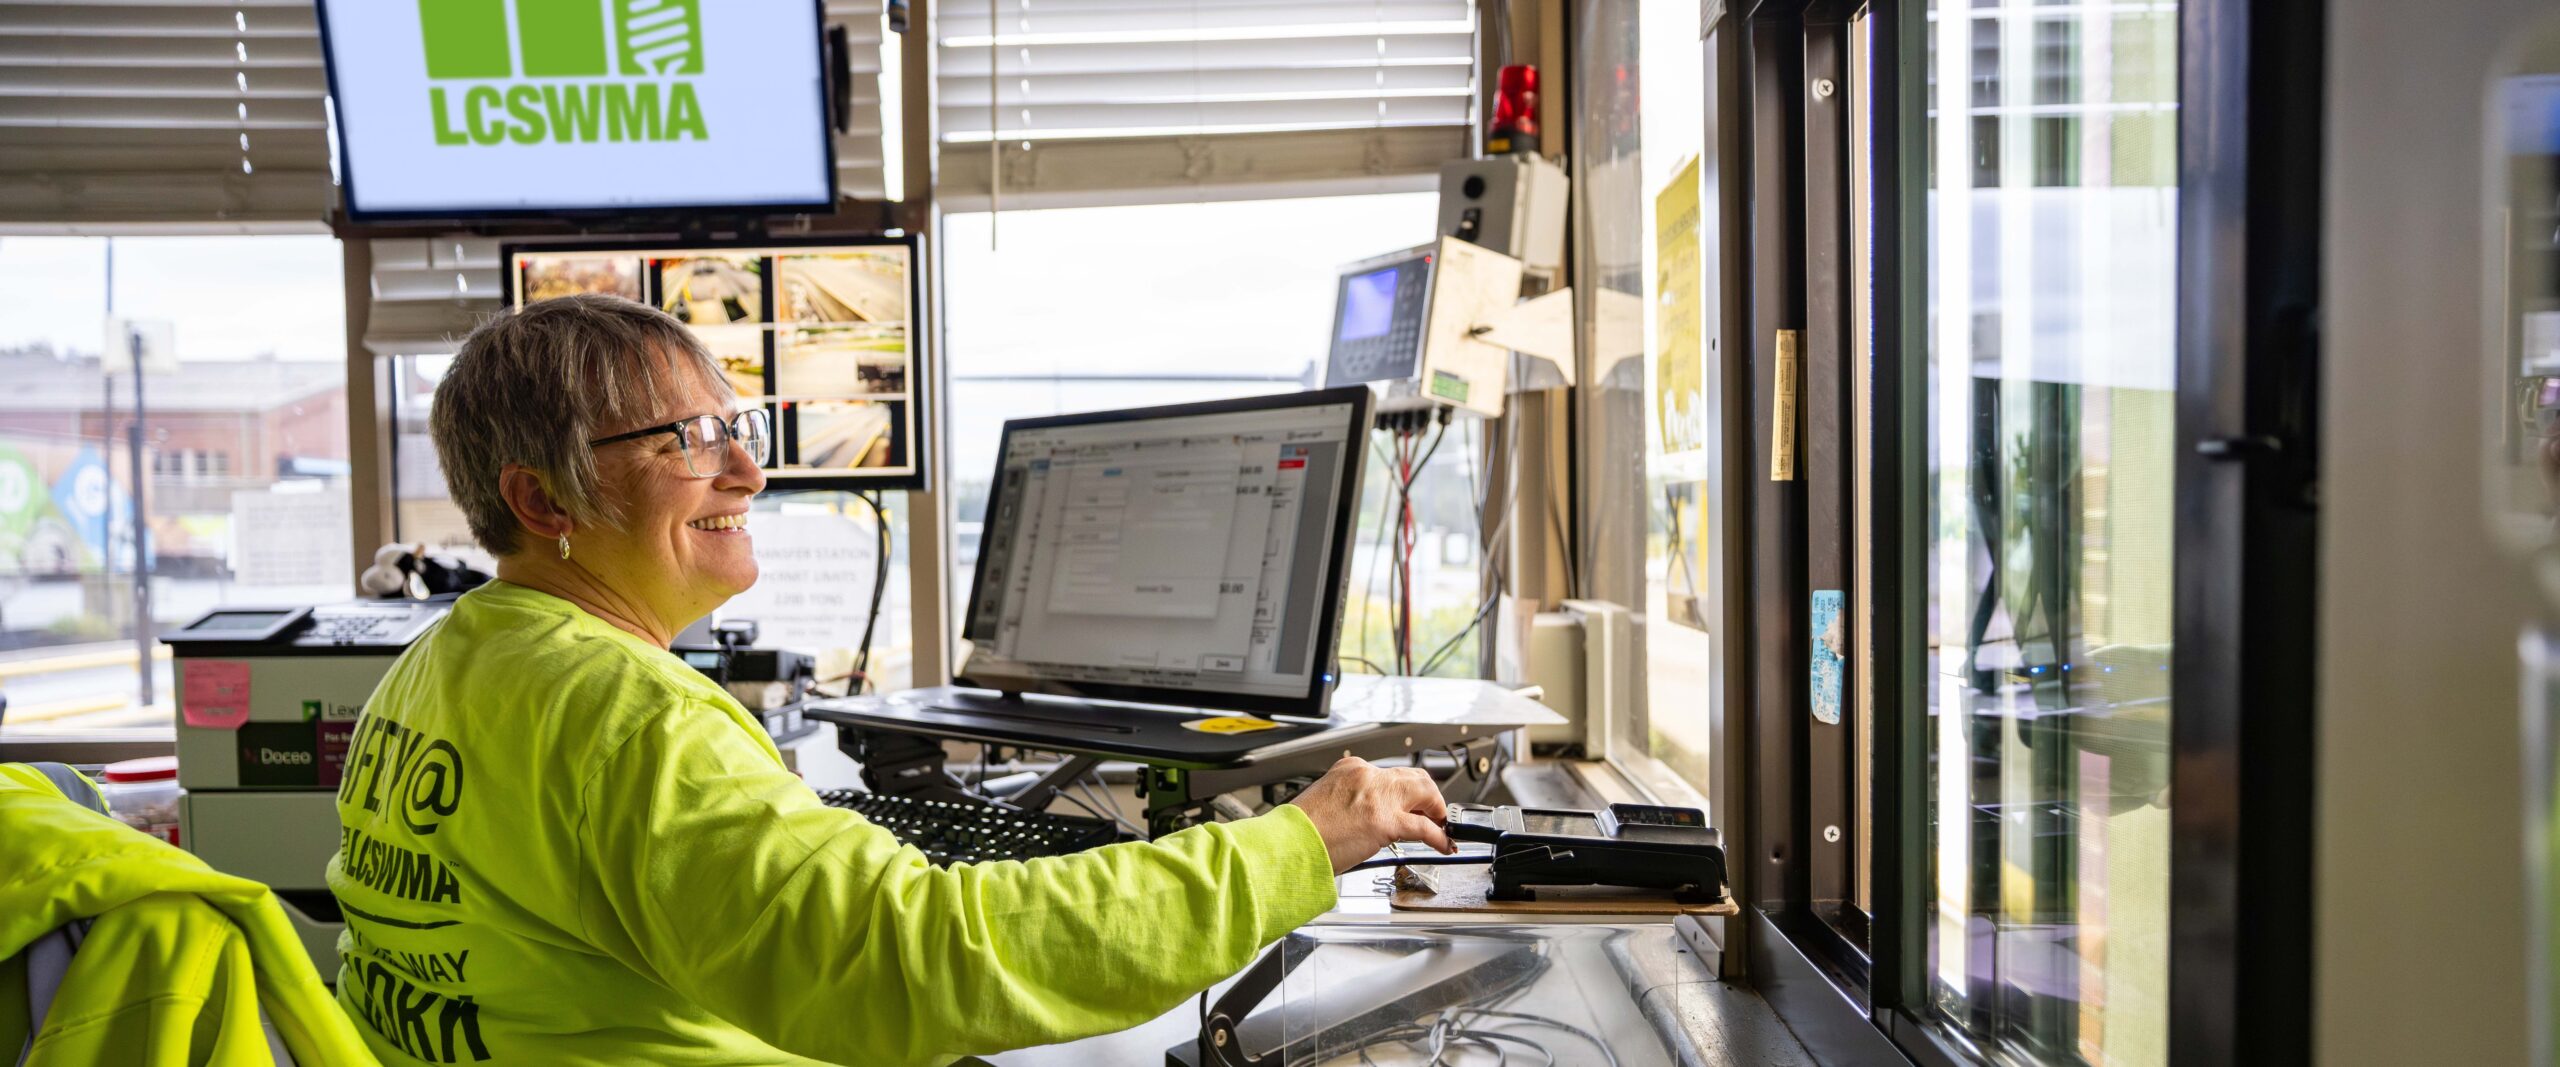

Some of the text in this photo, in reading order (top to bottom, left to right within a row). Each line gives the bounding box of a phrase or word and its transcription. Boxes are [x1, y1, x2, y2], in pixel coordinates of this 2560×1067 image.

[429, 82, 709, 146] LCSWMA
[754, 548, 812, 561] RANSFER
[261, 747, 312, 765] Doceo
[346, 828, 461, 904] LCSWMA
[399, 949, 470, 983] WAY
